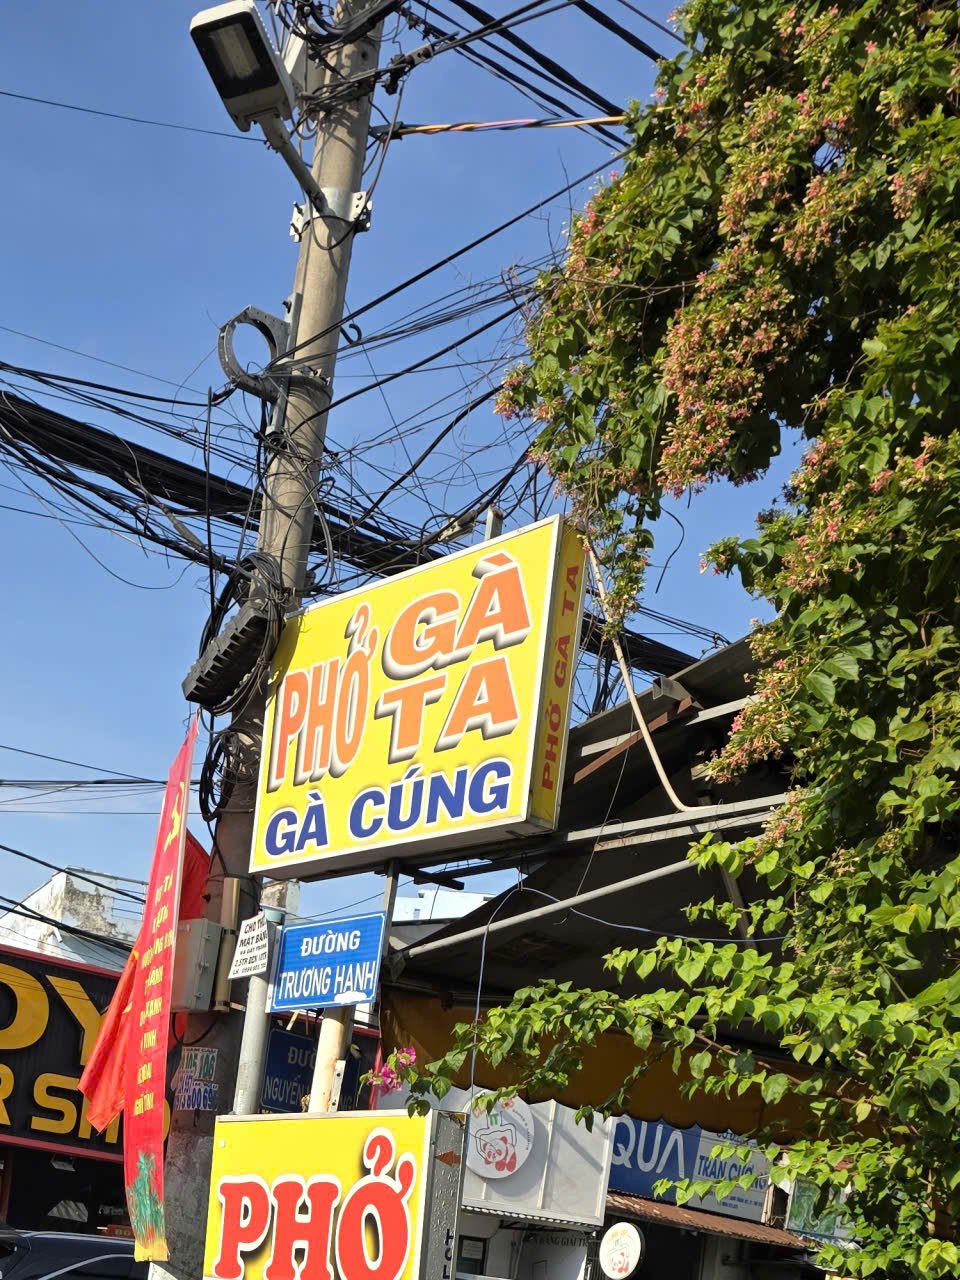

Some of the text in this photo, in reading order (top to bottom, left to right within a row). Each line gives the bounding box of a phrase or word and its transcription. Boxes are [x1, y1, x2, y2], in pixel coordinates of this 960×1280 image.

[273, 551, 531, 781] PHỞ GÀ
[380, 657, 520, 752] TA
[542, 565, 580, 791] PHỞ GÀ TA
[265, 760, 511, 856] GÀ CÚNG
[279, 964, 332, 1000] TRƯƠNG
[300, 929, 361, 957] ĐƯỜNG
